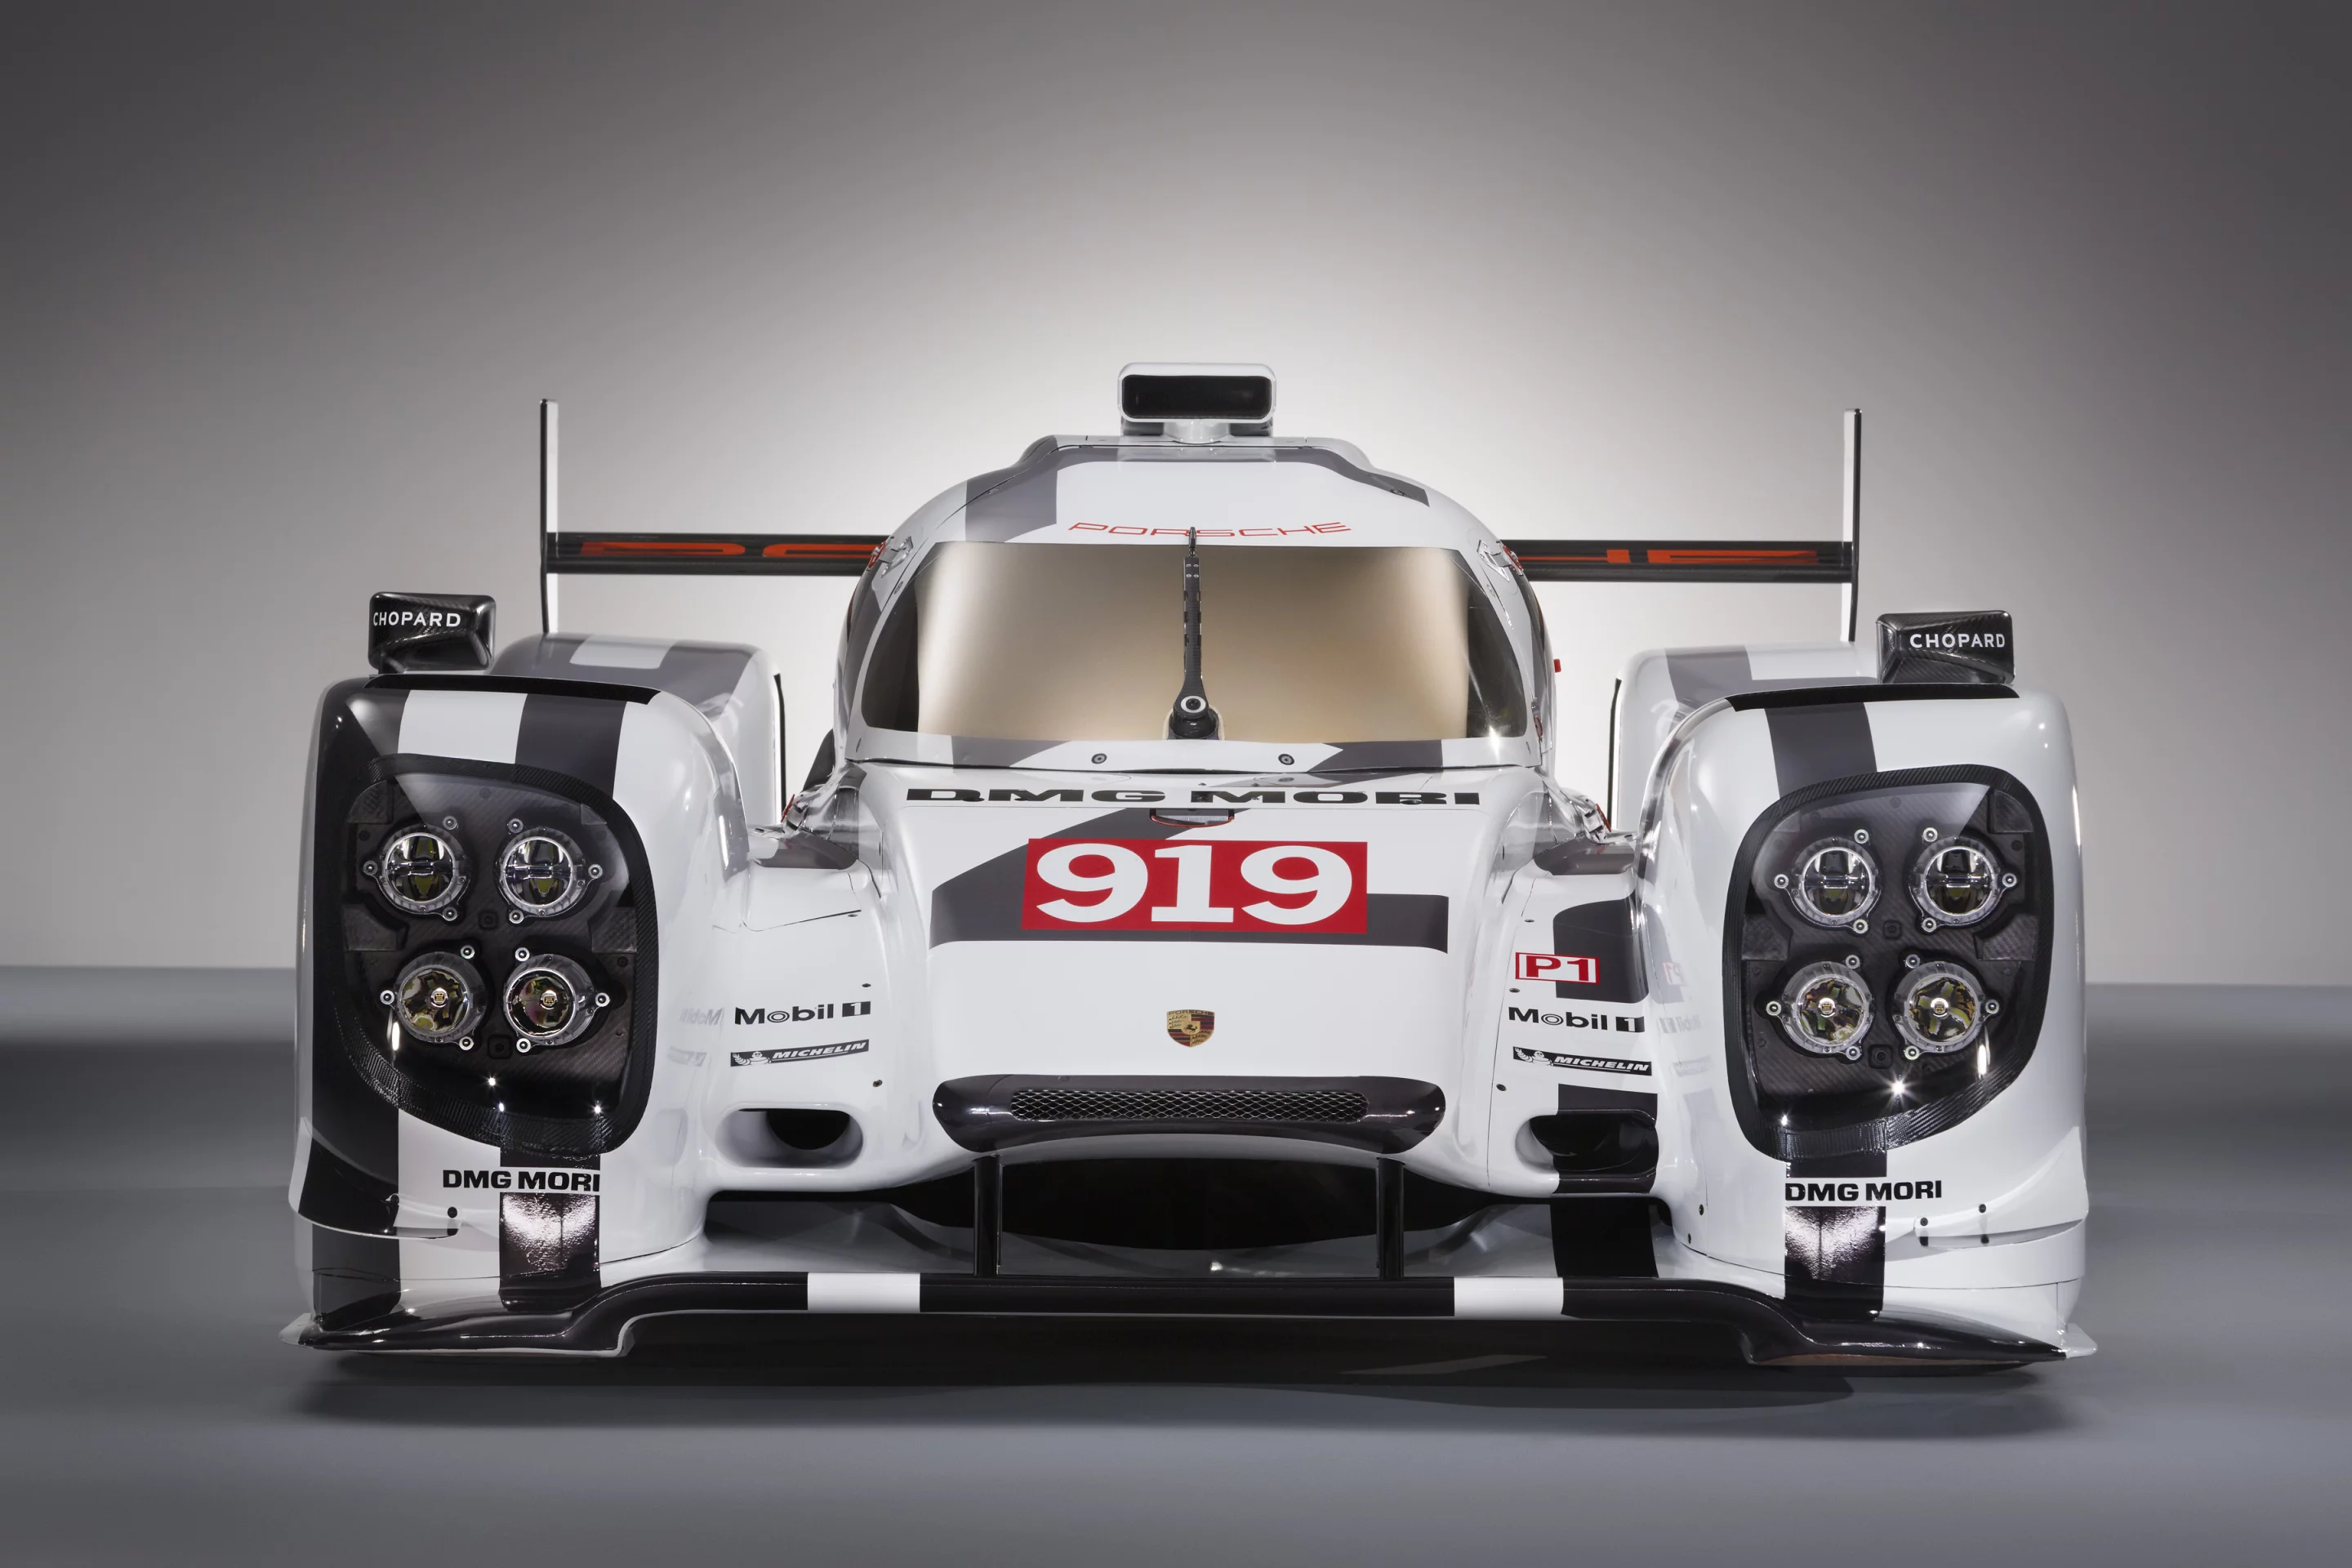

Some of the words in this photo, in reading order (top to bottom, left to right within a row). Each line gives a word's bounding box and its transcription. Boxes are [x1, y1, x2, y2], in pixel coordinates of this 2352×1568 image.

[1068, 522, 1352, 537] PORSCHE
[373, 612, 461, 626] CHOPARD
[1909, 633, 2006, 648] CHOPARD
[906, 789, 1166, 802] DMG
[1191, 791, 1480, 804] MORI
[1036, 843, 1352, 925] 919
[1526, 955, 1589, 982] P1
[735, 1004, 834, 1025] Mobil
[1508, 1007, 1608, 1031] Mobil
[772, 1042, 866, 1059] MICHELIN
[1553, 1056, 1649, 1071] MICHELIN
[443, 1169, 511, 1188] DMG
[518, 1171, 600, 1192] MORI
[1785, 1183, 1859, 1201] DMG
[1865, 1180, 1942, 1200] MORI
